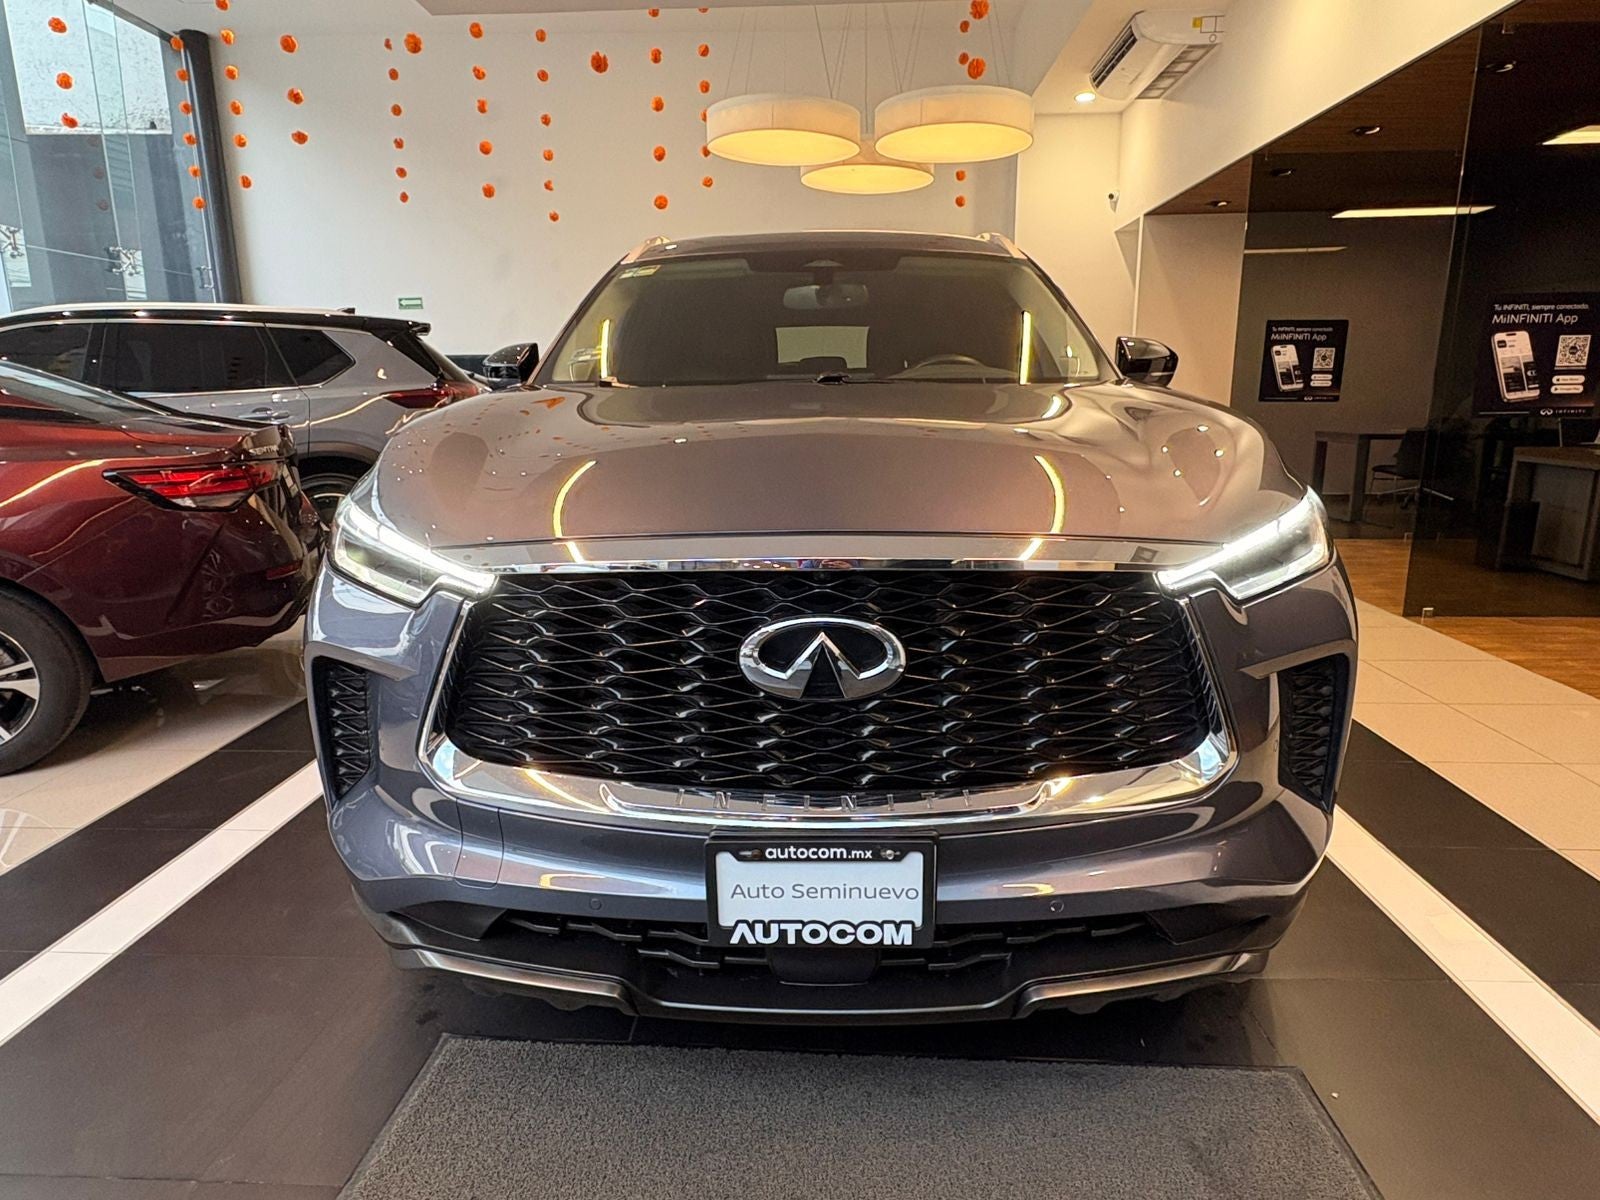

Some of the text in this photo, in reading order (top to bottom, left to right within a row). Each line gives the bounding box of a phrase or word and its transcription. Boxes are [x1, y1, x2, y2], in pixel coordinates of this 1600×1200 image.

[1555, 313, 1579, 325] App
[1312, 333, 1327, 342] App
[765, 845, 873, 860] autocom.mx
[730, 883, 919, 901] Auto Seminuevo
[730, 923, 913, 945] AUTOCOM
